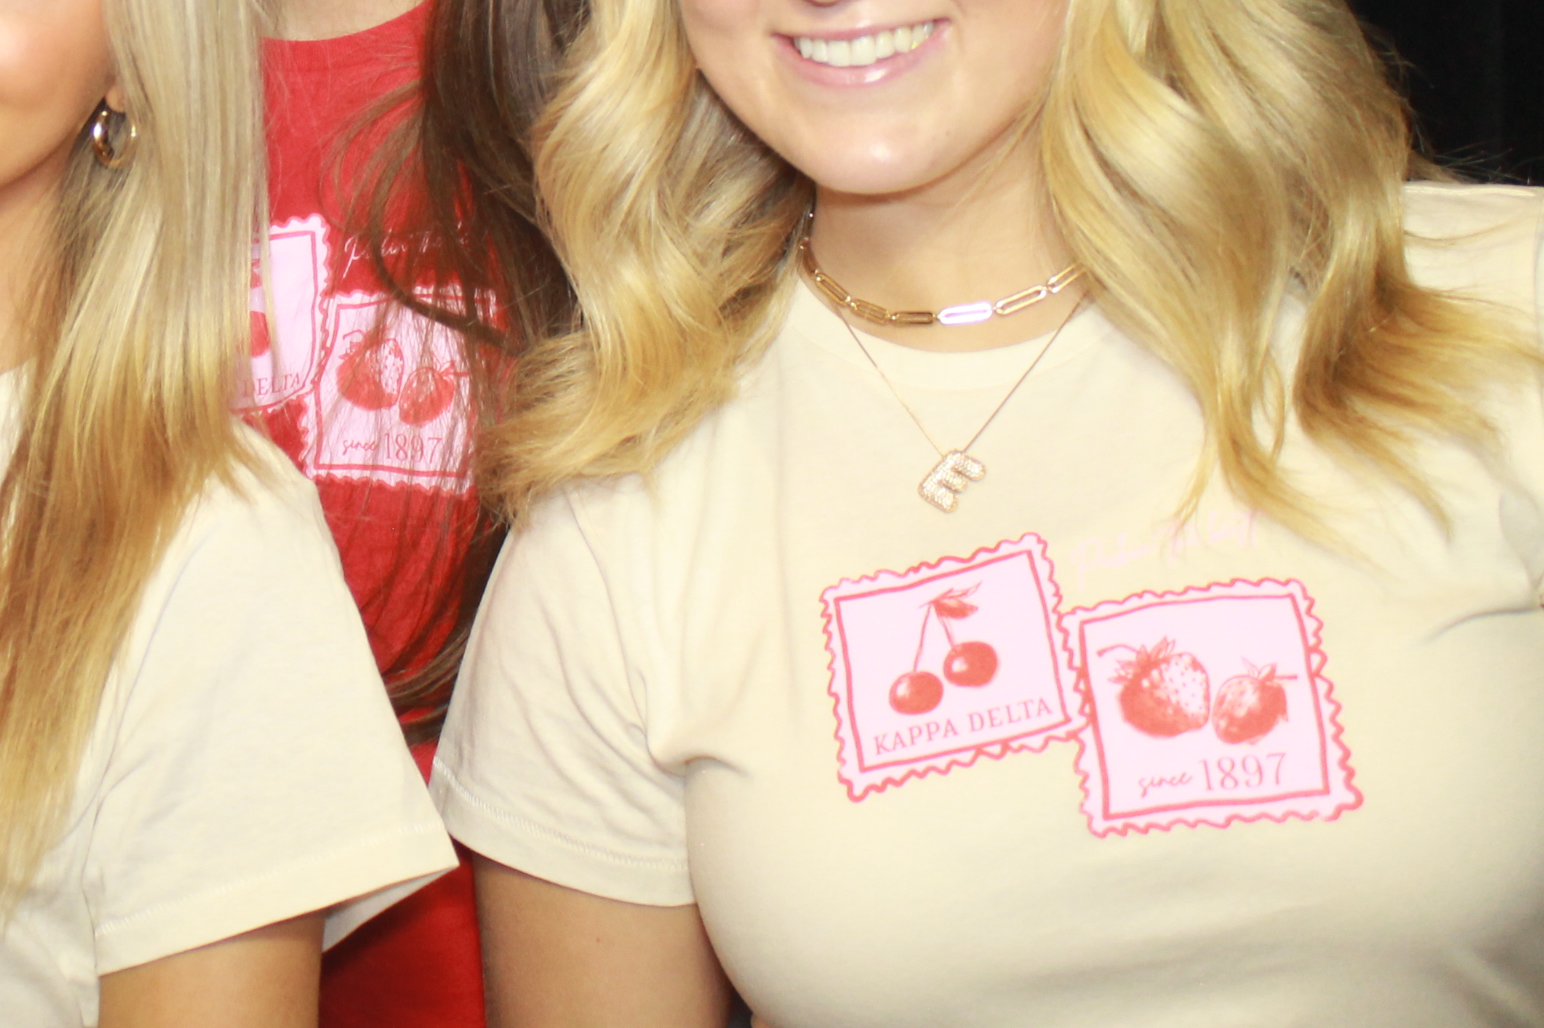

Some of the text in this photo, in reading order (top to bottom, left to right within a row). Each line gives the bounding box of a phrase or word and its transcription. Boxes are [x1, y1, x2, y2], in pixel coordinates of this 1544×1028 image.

[342, 432, 443, 465] since 1897
[918, 449, 987, 514] E
[873, 697, 1053, 756] KAPPA DELTA
[1138, 752, 1287, 798] since 1897
